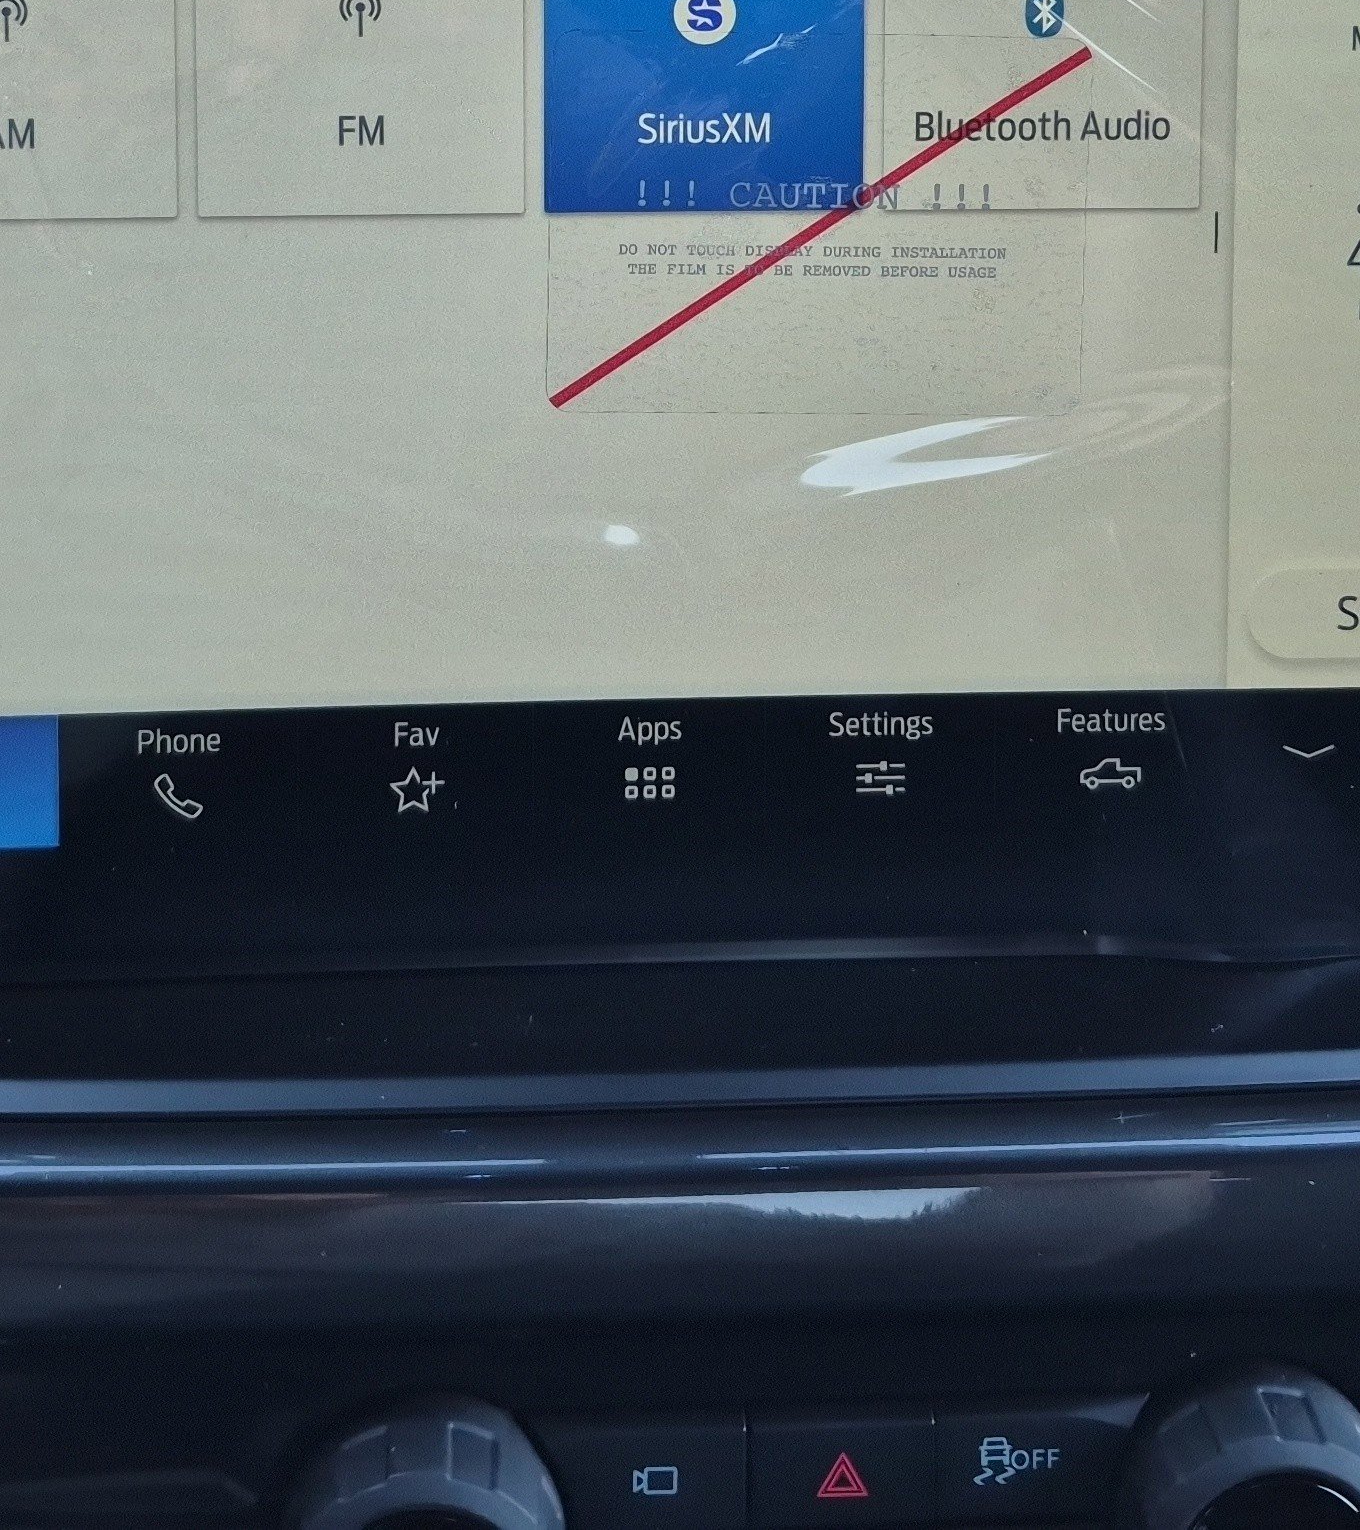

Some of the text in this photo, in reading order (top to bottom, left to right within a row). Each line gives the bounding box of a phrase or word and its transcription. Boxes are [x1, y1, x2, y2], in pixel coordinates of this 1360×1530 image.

[337, 116, 386, 148] FM
[637, 112, 772, 144] SiriusXM
[914, 110, 1171, 142] Bluetooth Audio
[729, 181, 901, 209] CAUTION
[618, 243, 638, 256] DO
[647, 243, 678, 256] NOT
[687, 244, 736, 257] TOUCH
[823, 246, 882, 258] DURING
[890, 247, 1007, 260] INSTALLATION
[627, 263, 657, 276] THE
[667, 263, 707, 276] FILM
[716, 264, 735, 276] IS
[773, 264, 794, 277] BE
[802, 264, 871, 278] REMOVED
[880, 265, 939, 278] BEFORE
[948, 265, 998, 279] USAGE
[393, 721, 441, 748] Fav
[617, 715, 683, 745] Apps
[828, 710, 934, 741] Settings
[1056, 707, 1167, 734] Features
[137, 728, 222, 756] Phone
[1011, 1448, 1061, 1470] OFF
